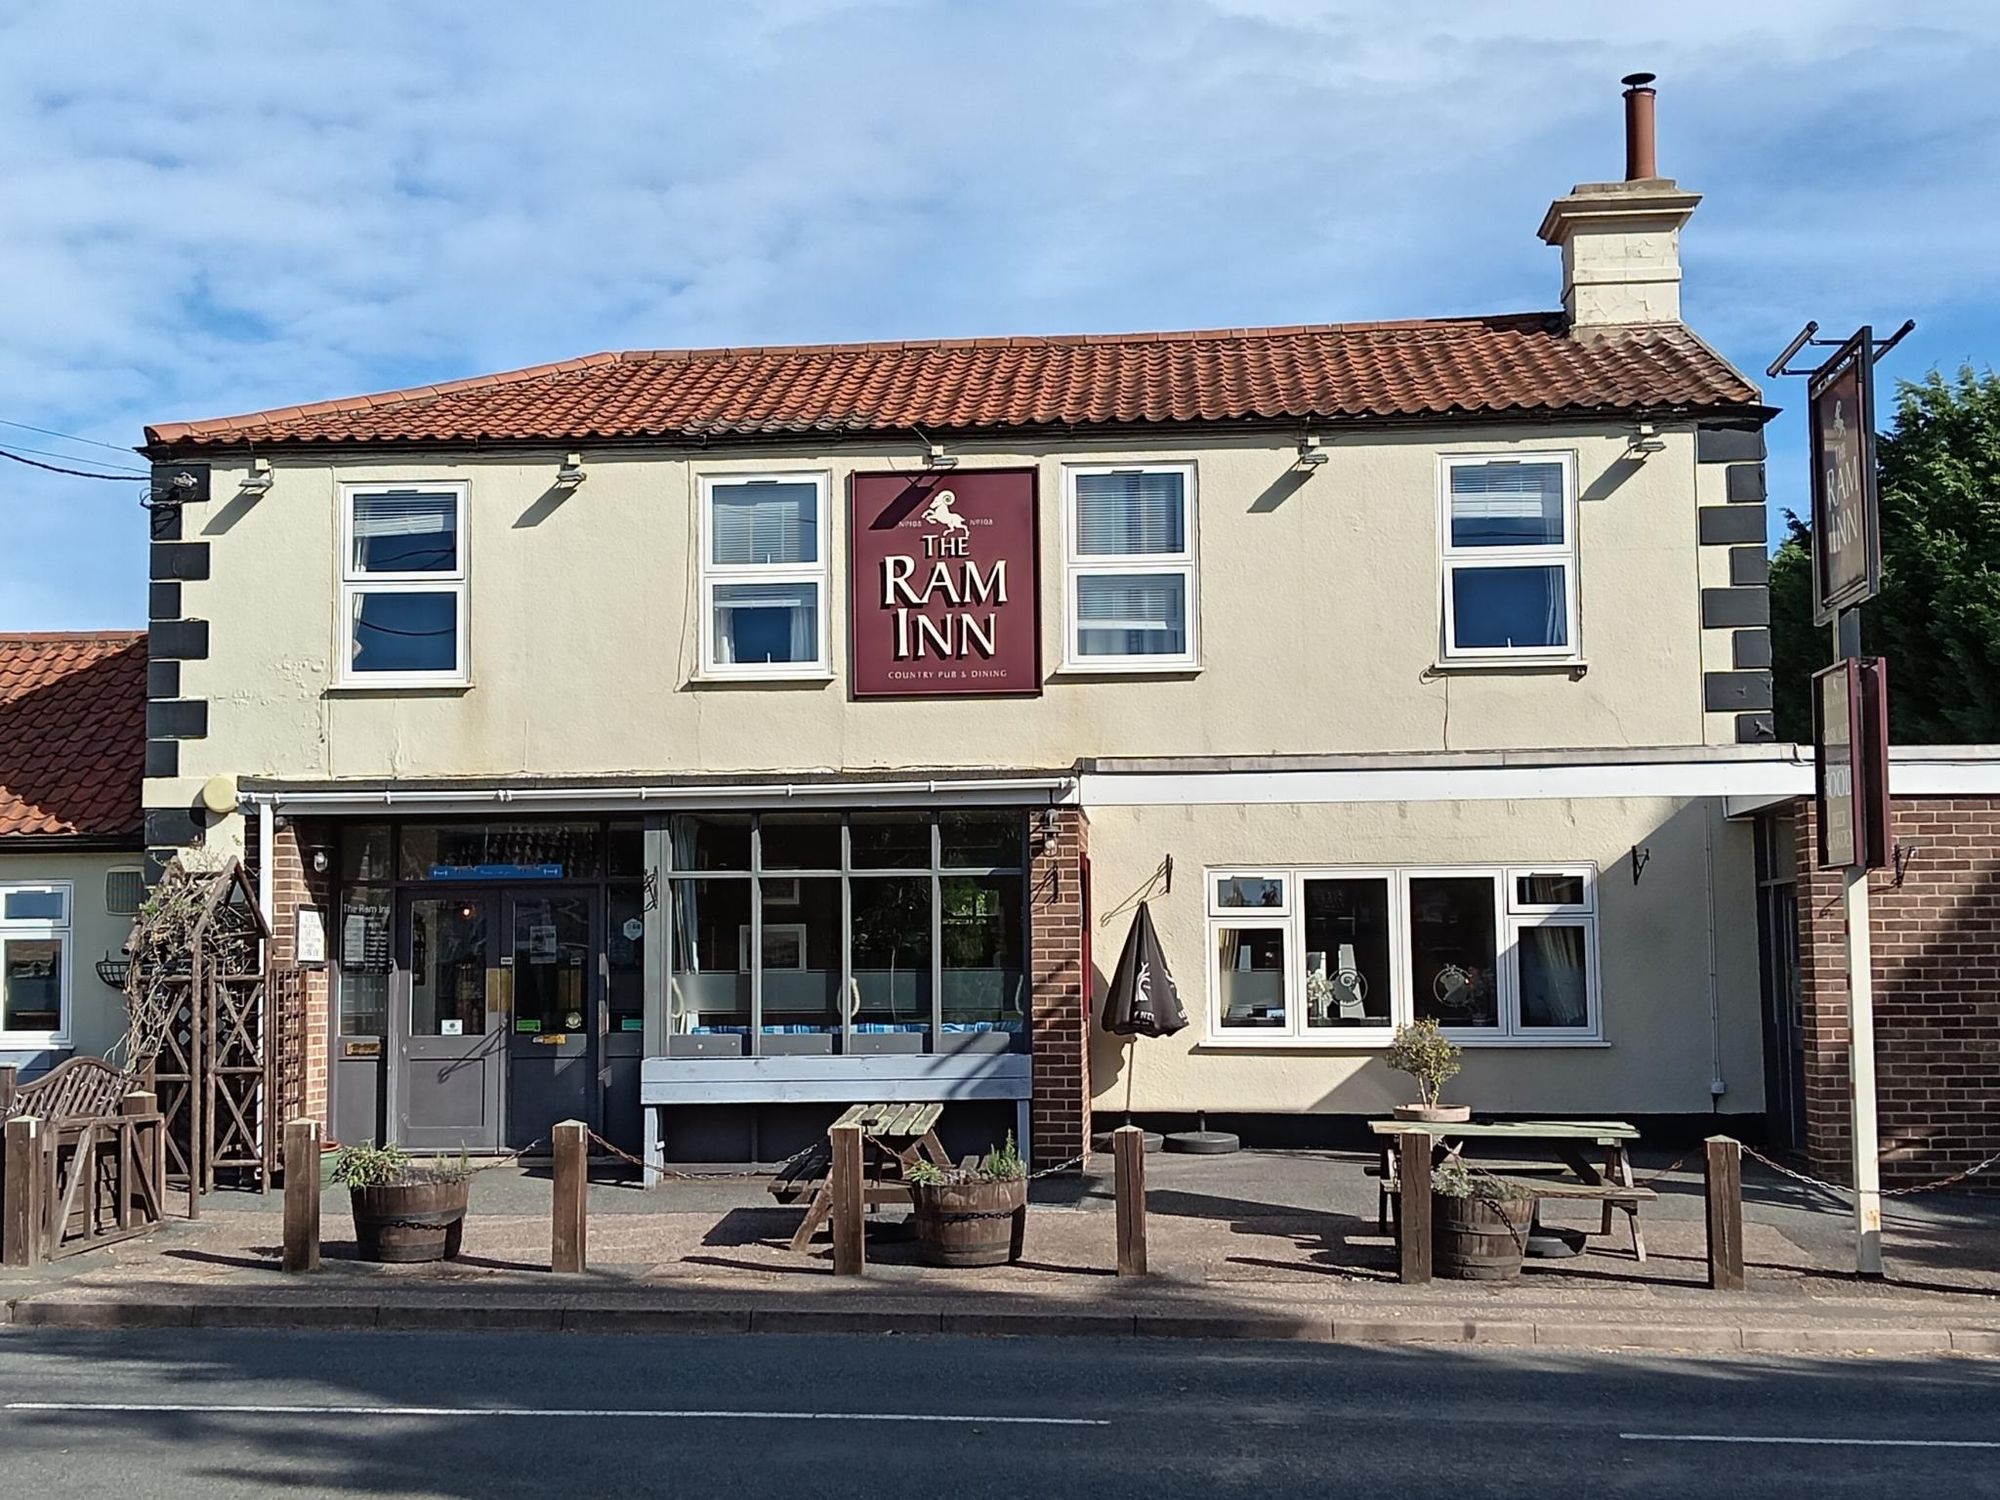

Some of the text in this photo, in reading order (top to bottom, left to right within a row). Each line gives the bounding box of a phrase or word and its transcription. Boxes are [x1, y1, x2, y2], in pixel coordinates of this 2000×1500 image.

[1826, 456, 1859, 512] RAM
[922, 534, 970, 556] THE
[1831, 503, 1858, 554] INN
[884, 555, 1008, 605] RAM
[897, 607, 996, 657] INN
[887, 671, 934, 679] COUNTRY
[961, 670, 967, 678] &
[971, 669, 1008, 678] DINING
[343, 903, 357, 913] The
[358, 903, 377, 913] Ram
